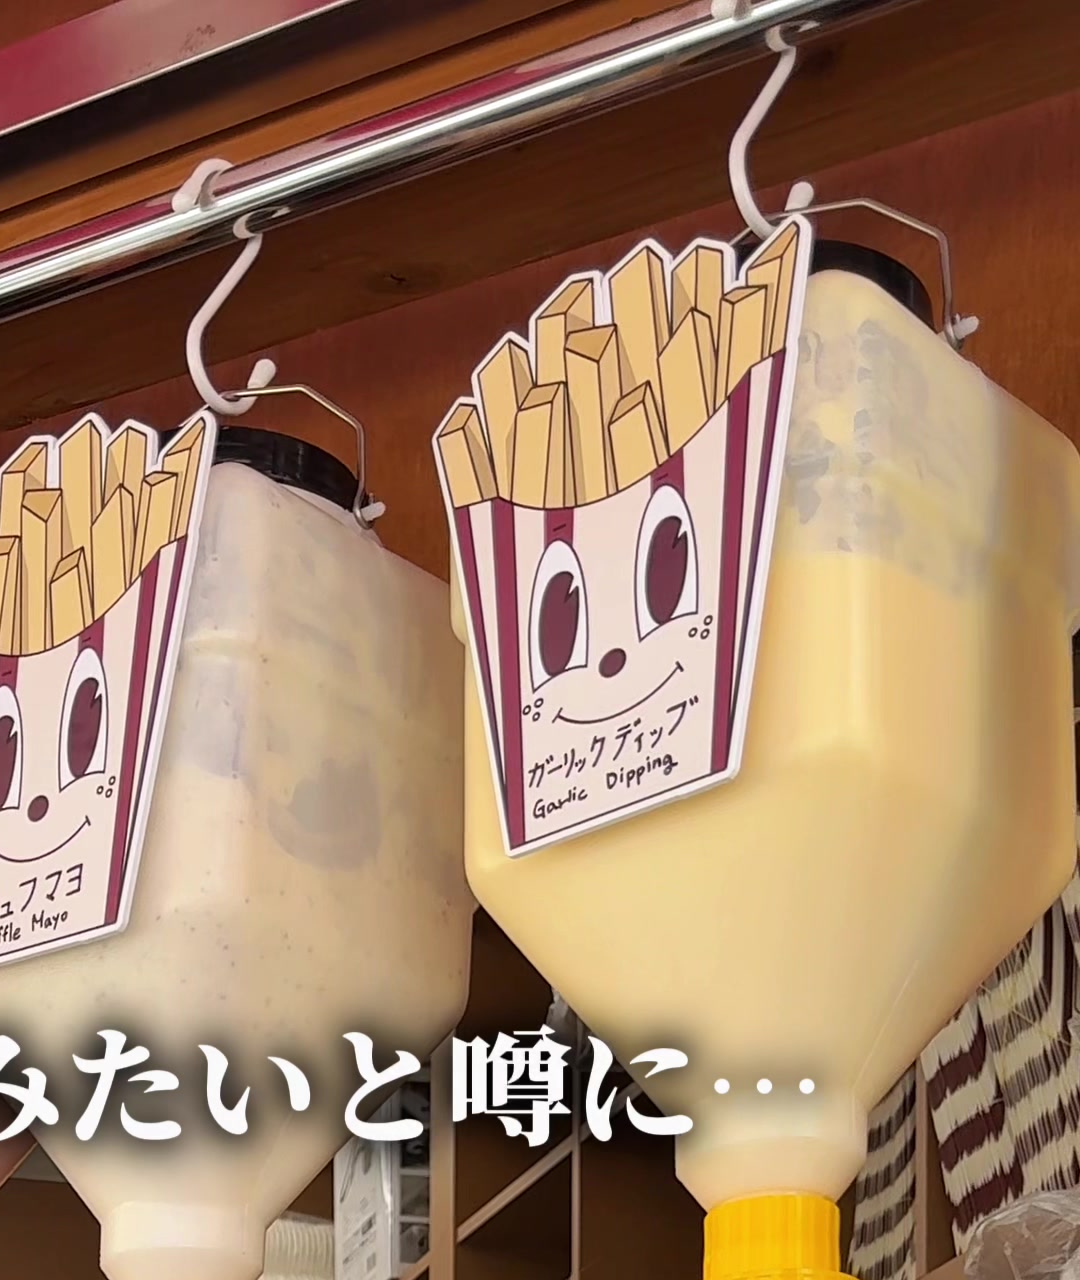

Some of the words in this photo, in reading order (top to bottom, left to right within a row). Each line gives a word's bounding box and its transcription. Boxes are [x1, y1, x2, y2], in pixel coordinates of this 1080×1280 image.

[532, 786, 588, 819] Garlic
[606, 754, 678, 790] Dipping
[31, 910, 68, 932] Mayo
